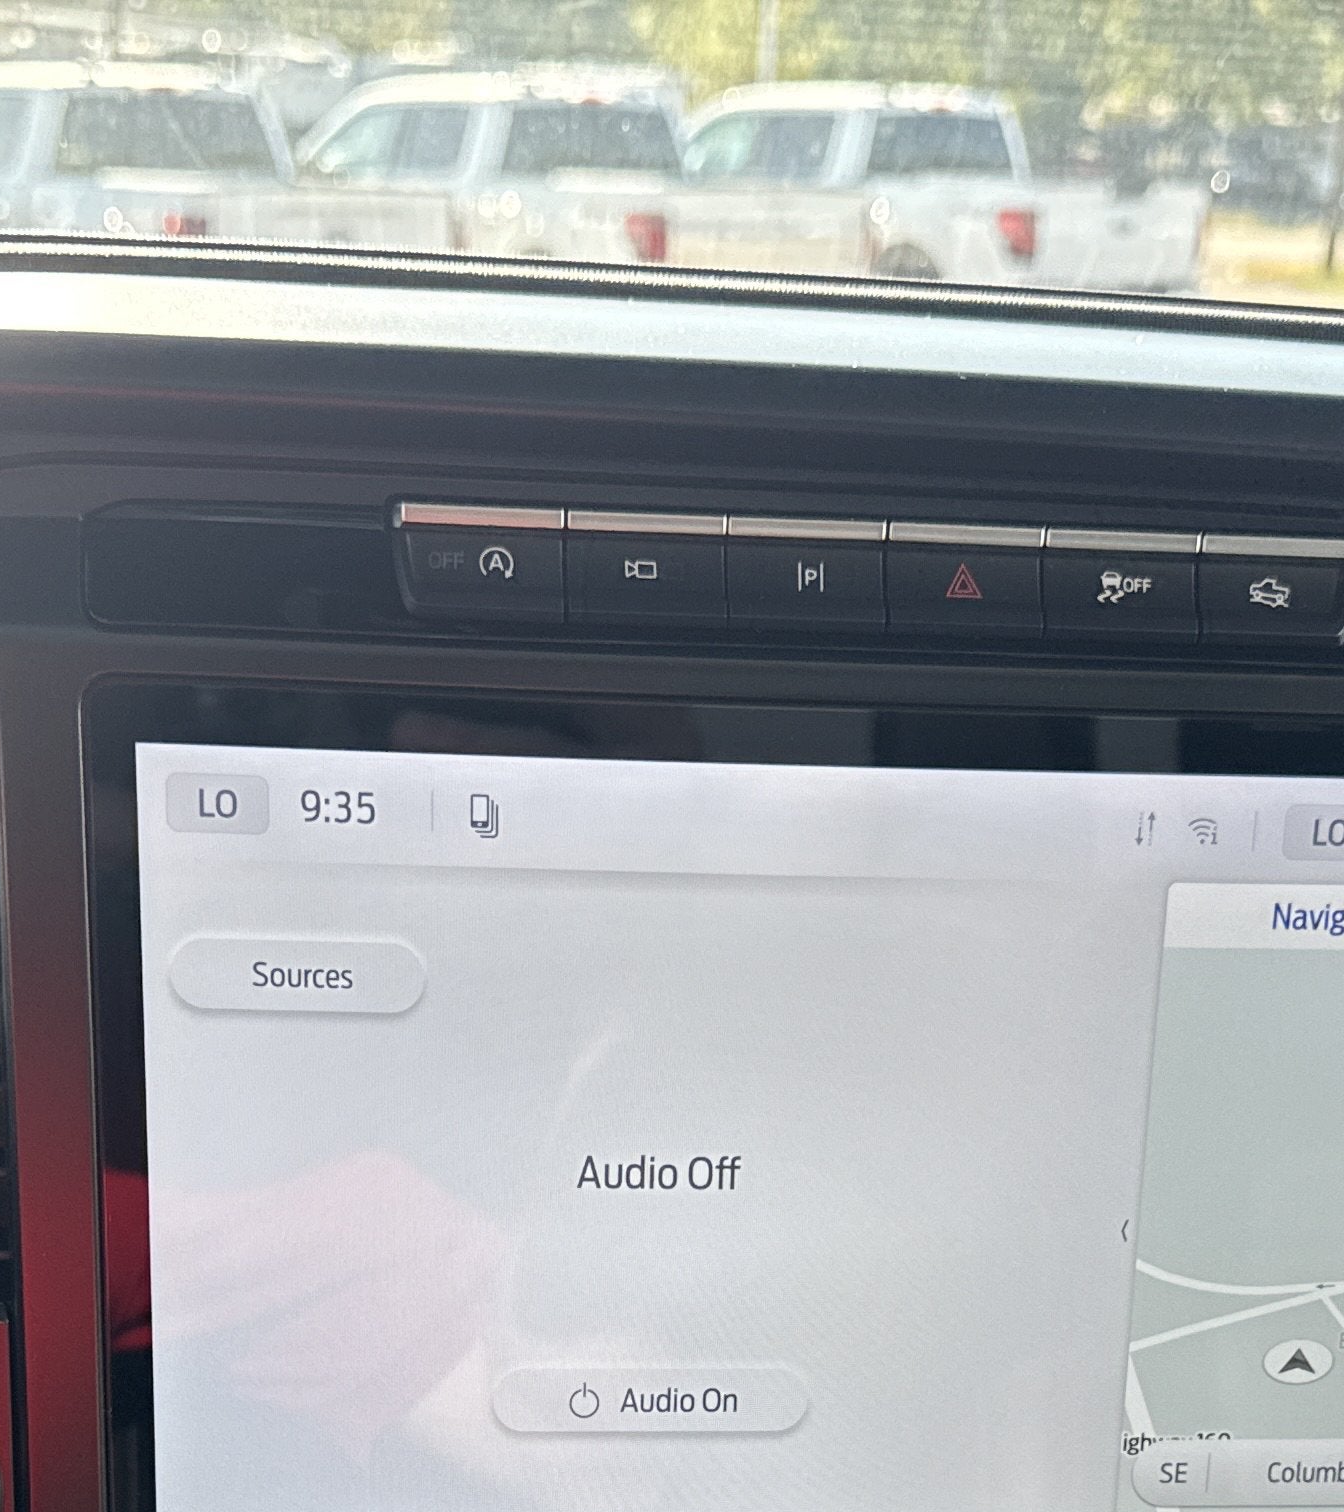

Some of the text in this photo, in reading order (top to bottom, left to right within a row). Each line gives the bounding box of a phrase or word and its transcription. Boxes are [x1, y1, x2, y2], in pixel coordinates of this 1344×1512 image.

[427, 551, 465, 571] OFF
[1123, 576, 1152, 594] OFF
[197, 788, 239, 819] LO
[299, 790, 377, 825] 9:35
[251, 961, 355, 990] Sources
[576, 1154, 742, 1191] Audio Off
[620, 1387, 738, 1414] Audio On
[1159, 1462, 1188, 1483] SE
